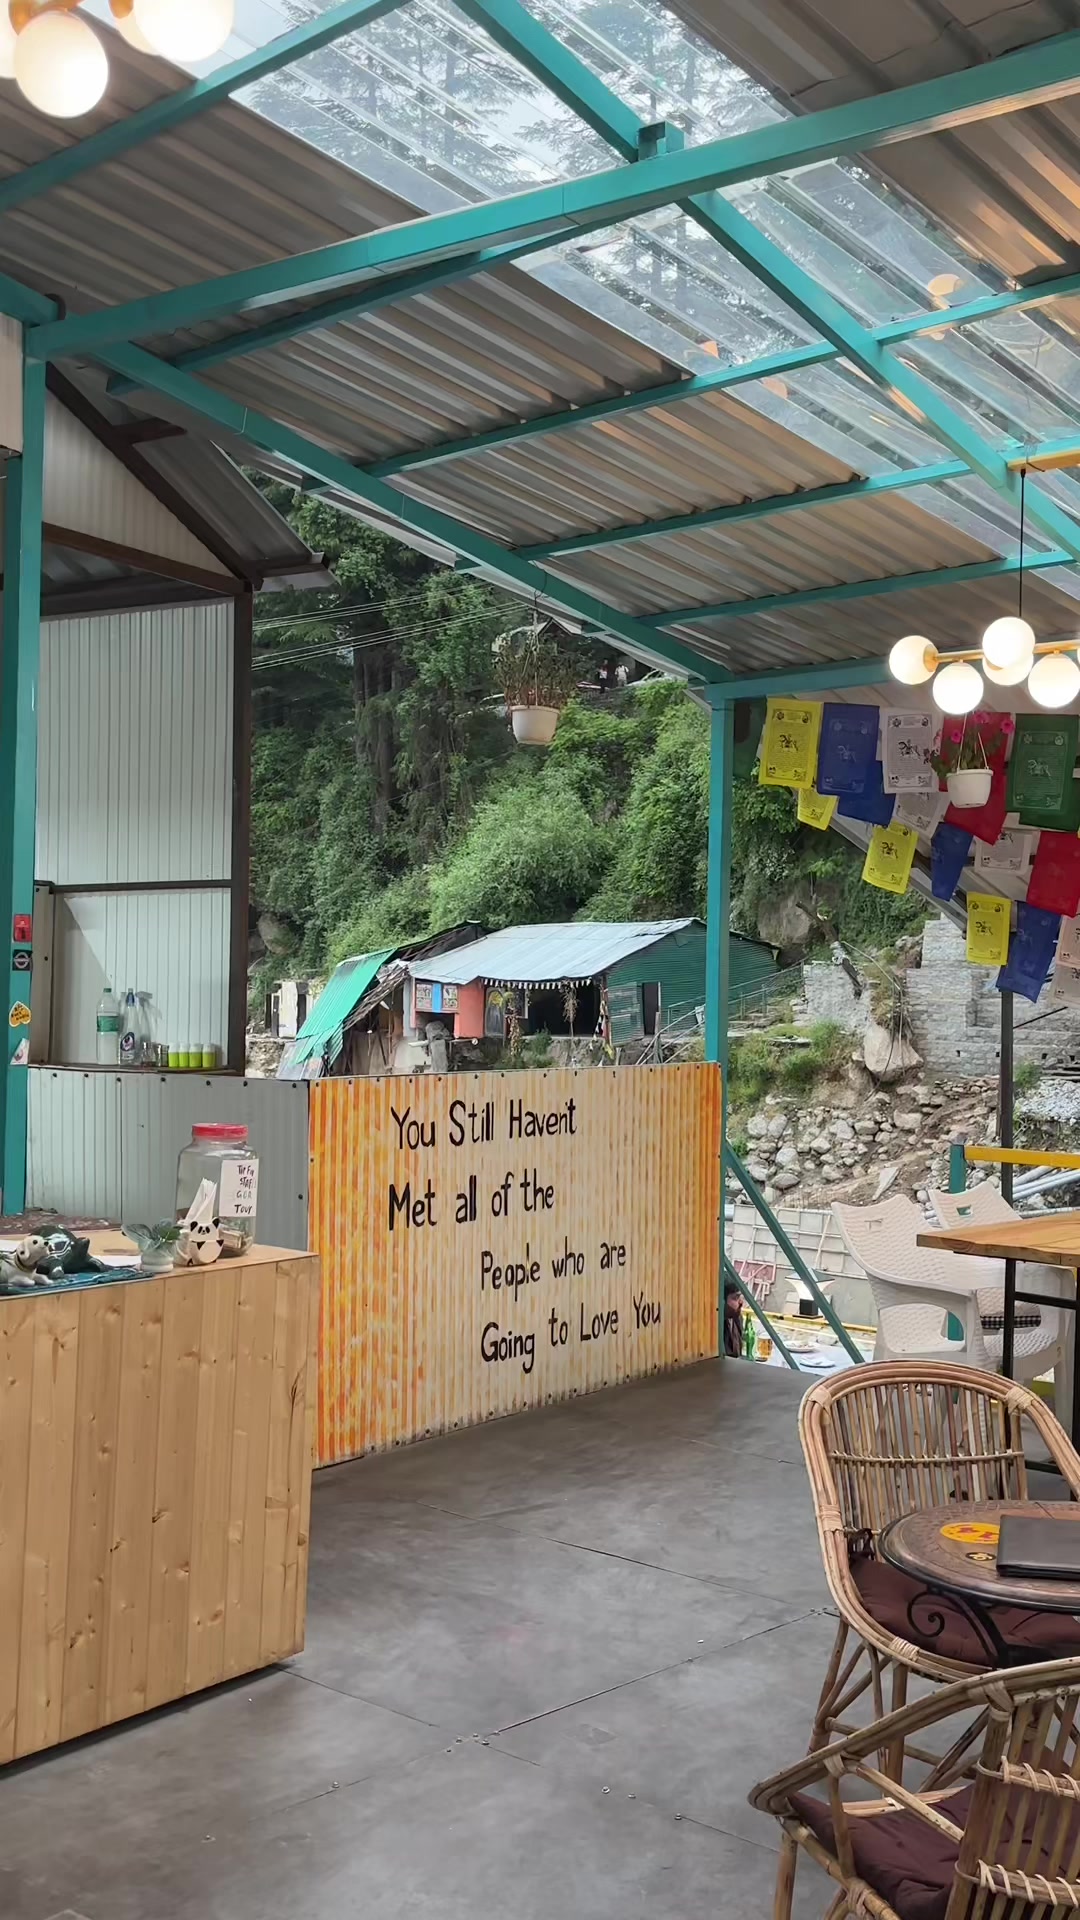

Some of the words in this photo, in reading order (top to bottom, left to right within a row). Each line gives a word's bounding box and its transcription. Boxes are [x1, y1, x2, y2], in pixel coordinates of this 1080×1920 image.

[390, 1106, 436, 1150] You
[448, 1099, 495, 1147] Still
[388, 1178, 438, 1231] Met
[455, 1174, 477, 1224] all
[491, 1171, 515, 1217] of
[519, 1167, 555, 1213] the
[480, 1242, 541, 1302] People
[551, 1235, 585, 1279] who
[599, 1242, 627, 1270] are
[480, 1321, 535, 1374] Going
[548, 1307, 568, 1347] to
[579, 1302, 619, 1342] Love
[632, 1291, 662, 1329] You
